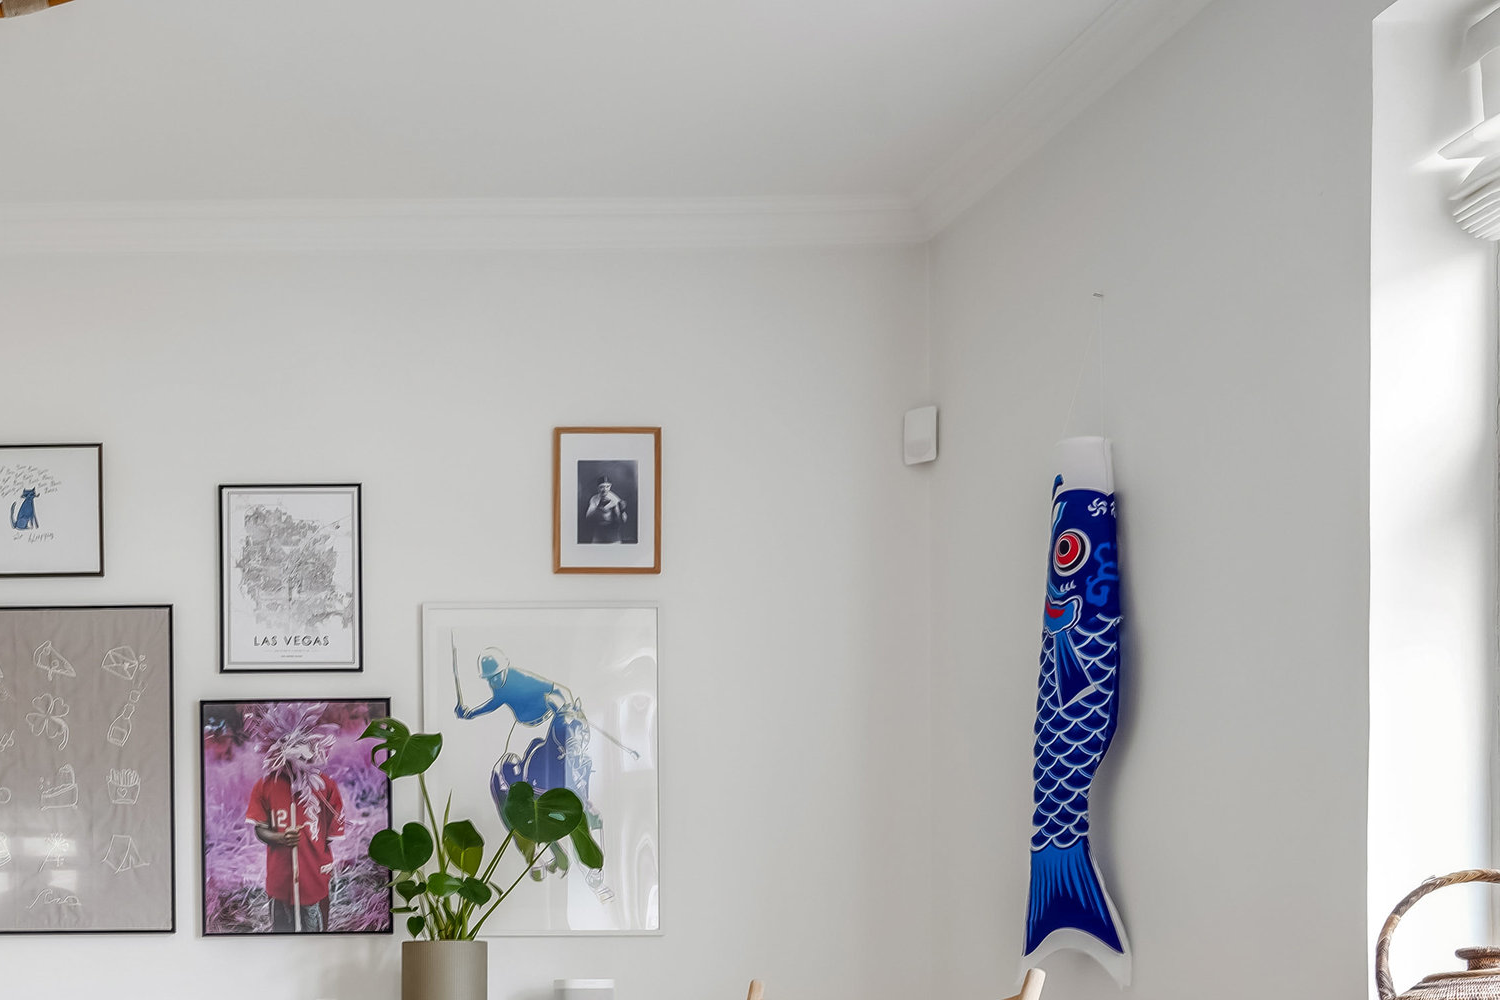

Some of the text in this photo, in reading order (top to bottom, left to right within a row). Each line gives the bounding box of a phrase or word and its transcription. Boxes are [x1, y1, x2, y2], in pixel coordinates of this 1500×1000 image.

[254, 635, 330, 646] LAS VEGAS
[271, 809, 287, 828] 12
